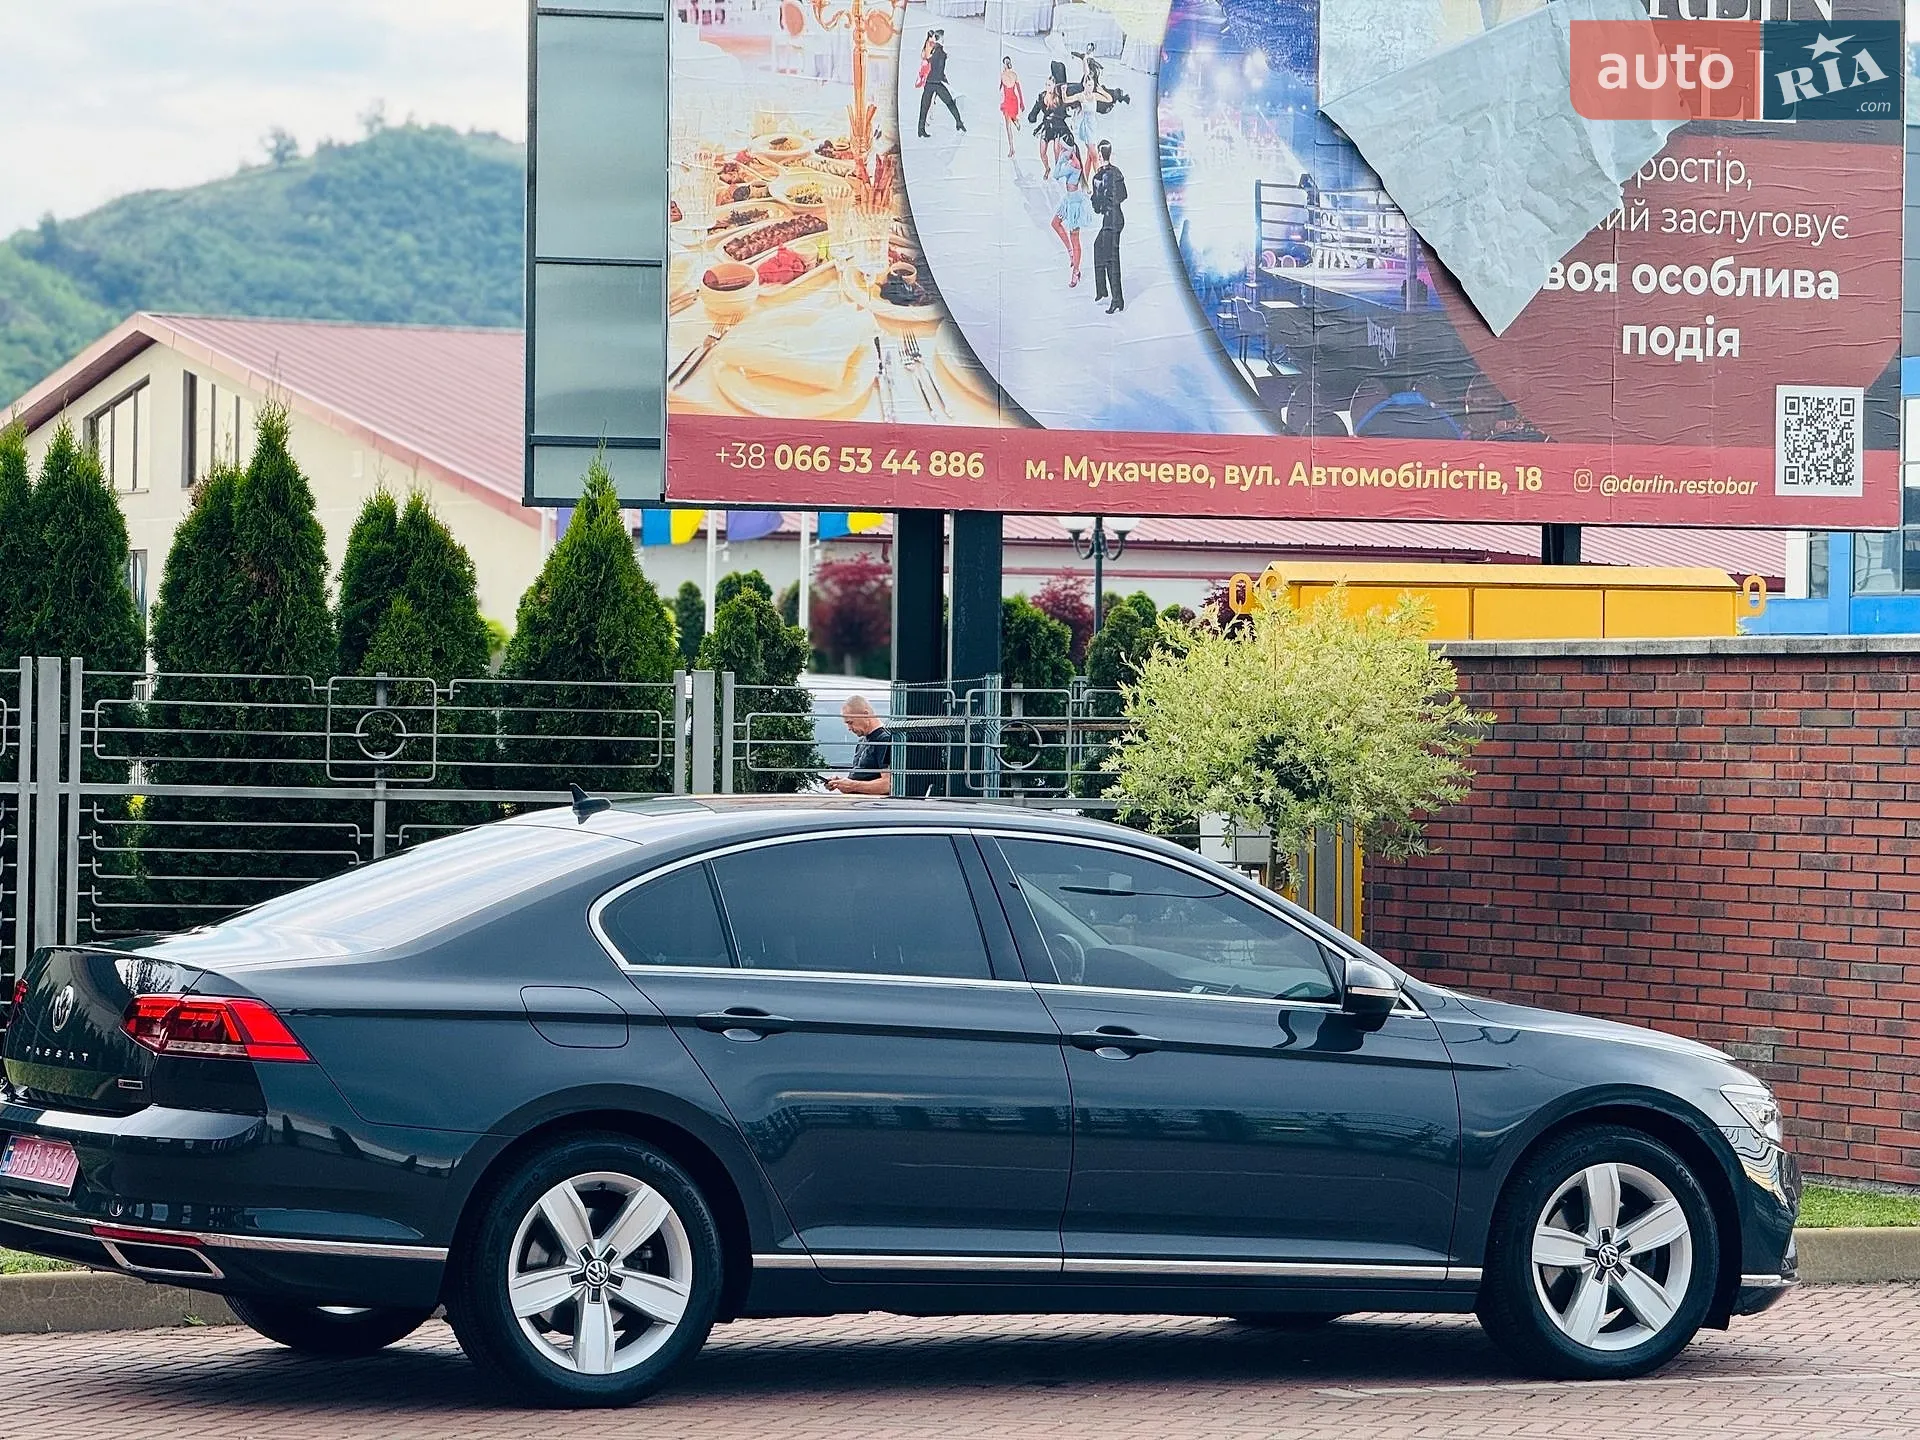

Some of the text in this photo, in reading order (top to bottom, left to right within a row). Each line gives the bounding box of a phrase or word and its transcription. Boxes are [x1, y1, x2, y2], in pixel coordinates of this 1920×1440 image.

[1636, 150, 1753, 193] ростір,
[1597, 198, 1850, 247] ий заслуговує
[1543, 256, 1840, 301] воя особлива
[1621, 314, 1741, 363] подія
[715, 442, 985, 478] +38 066 53 44 886
[1025, 455, 1543, 496] м. Мукачево, вул. Автомобілістів, 18
[1600, 474, 1759, 498] @darlin.restobar
[25, 1045, 89, 1062] PASSAT
